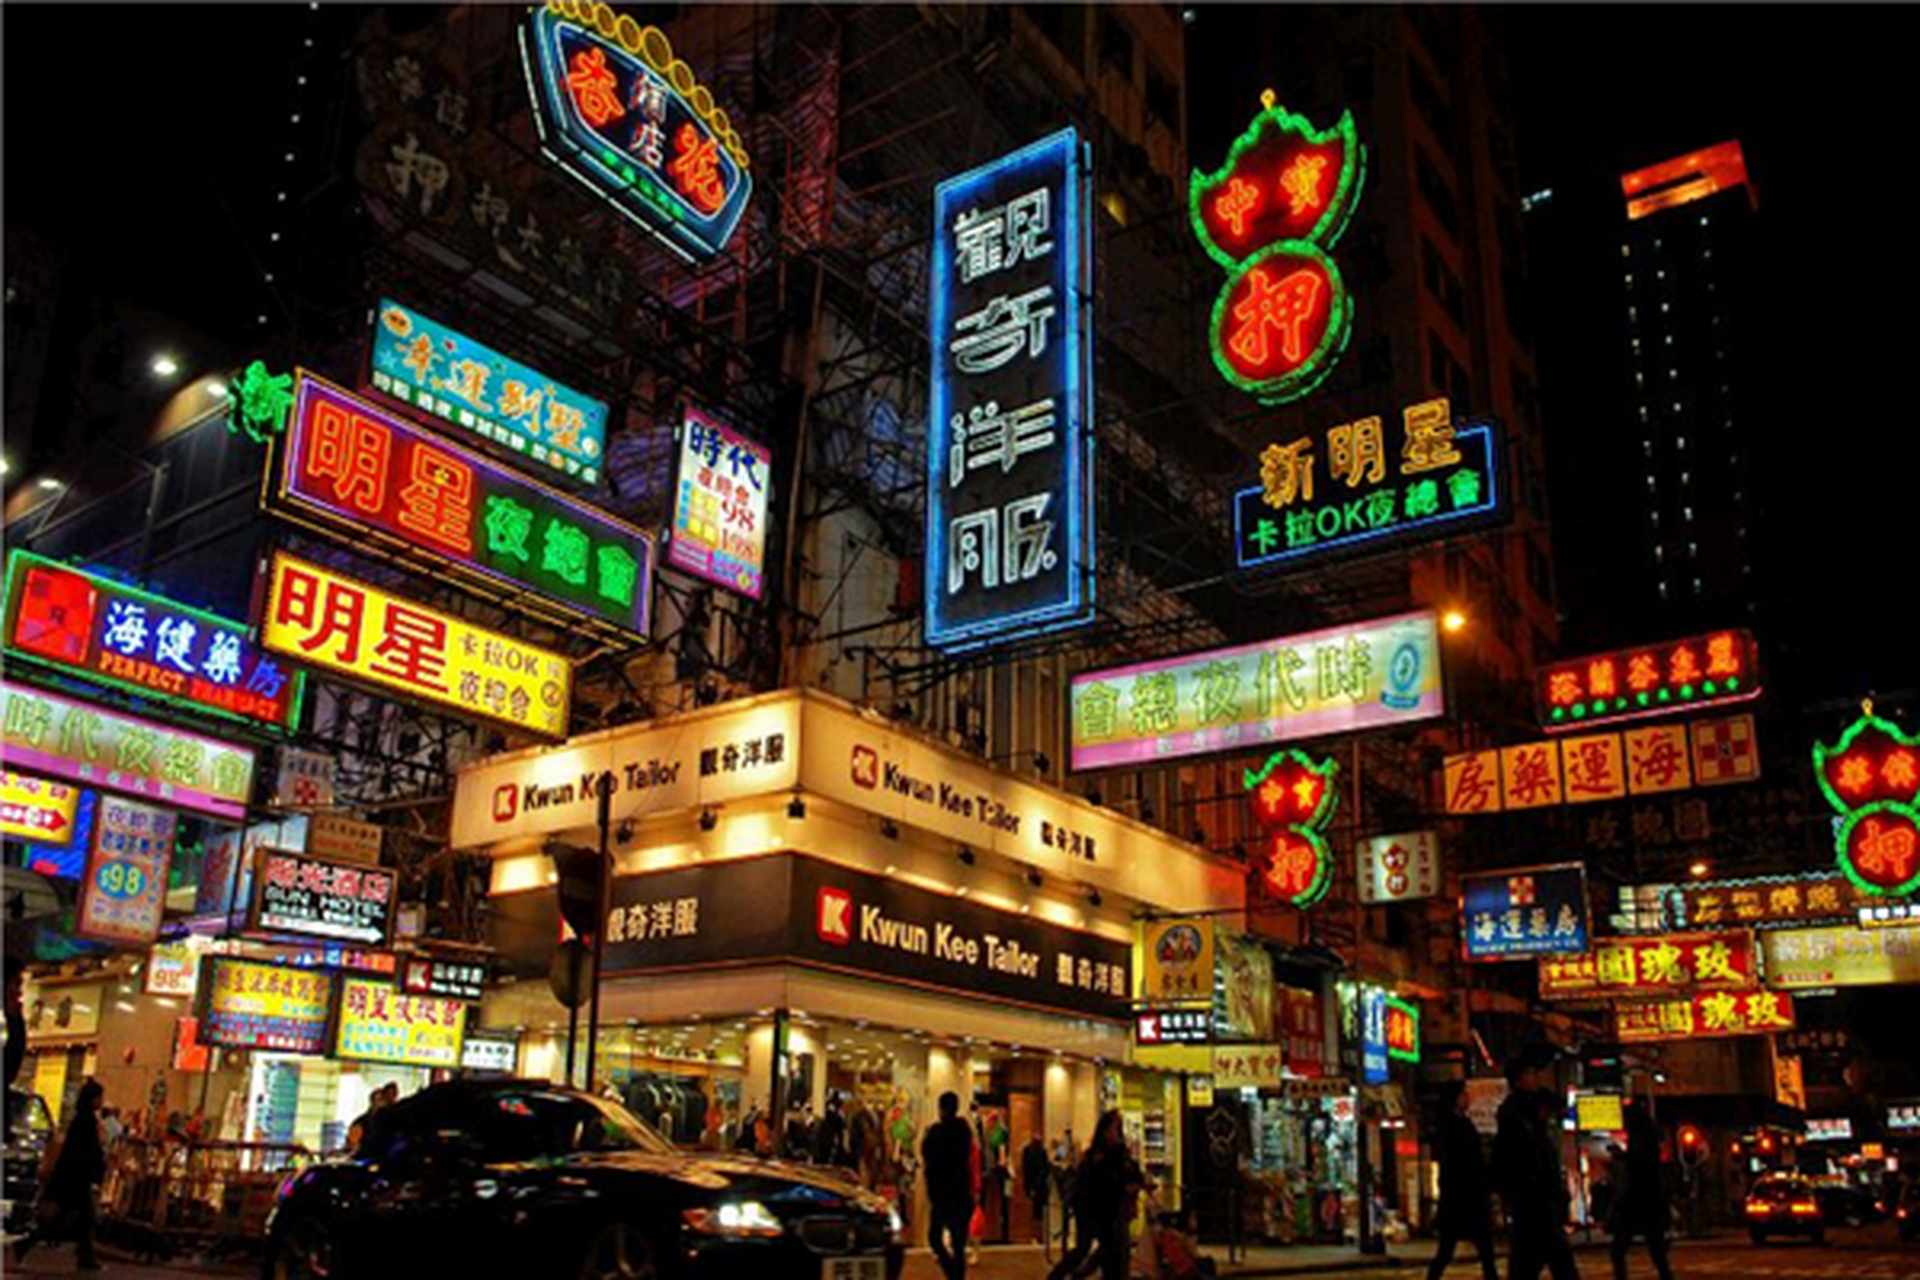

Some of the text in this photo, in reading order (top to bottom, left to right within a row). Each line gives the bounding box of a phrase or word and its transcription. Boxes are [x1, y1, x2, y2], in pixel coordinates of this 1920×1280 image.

[1229, 269, 1321, 362] 押
[99, 650, 186, 694] PERFECT
[860, 904, 929, 951] Kwun
[934, 922, 979, 965] Kee
[984, 935, 1040, 978] Tailor
